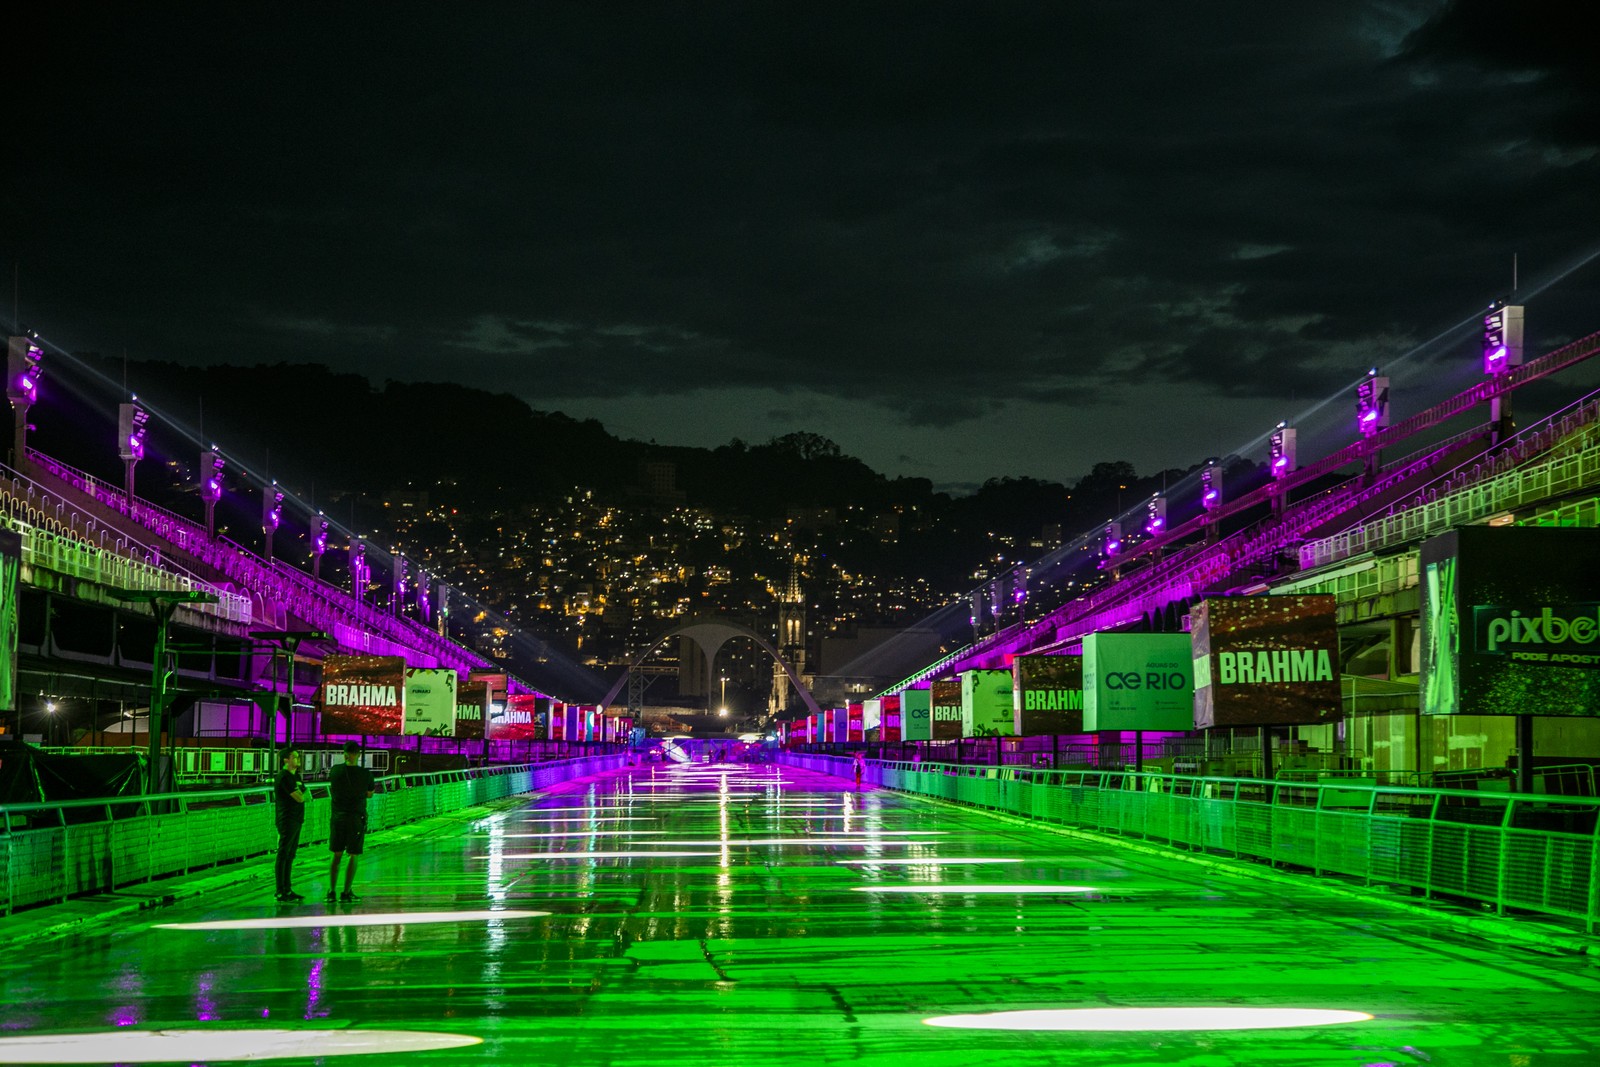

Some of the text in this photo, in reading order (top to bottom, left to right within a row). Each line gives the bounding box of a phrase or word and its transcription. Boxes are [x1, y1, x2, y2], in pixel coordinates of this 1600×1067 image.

[1488, 607, 1600, 651] pixbe
[1219, 649, 1333, 684] BRAHMA
[1511, 652, 1549, 662] PODE
[1146, 672, 1186, 690] RIO
[325, 685, 397, 707] BRAHMA
